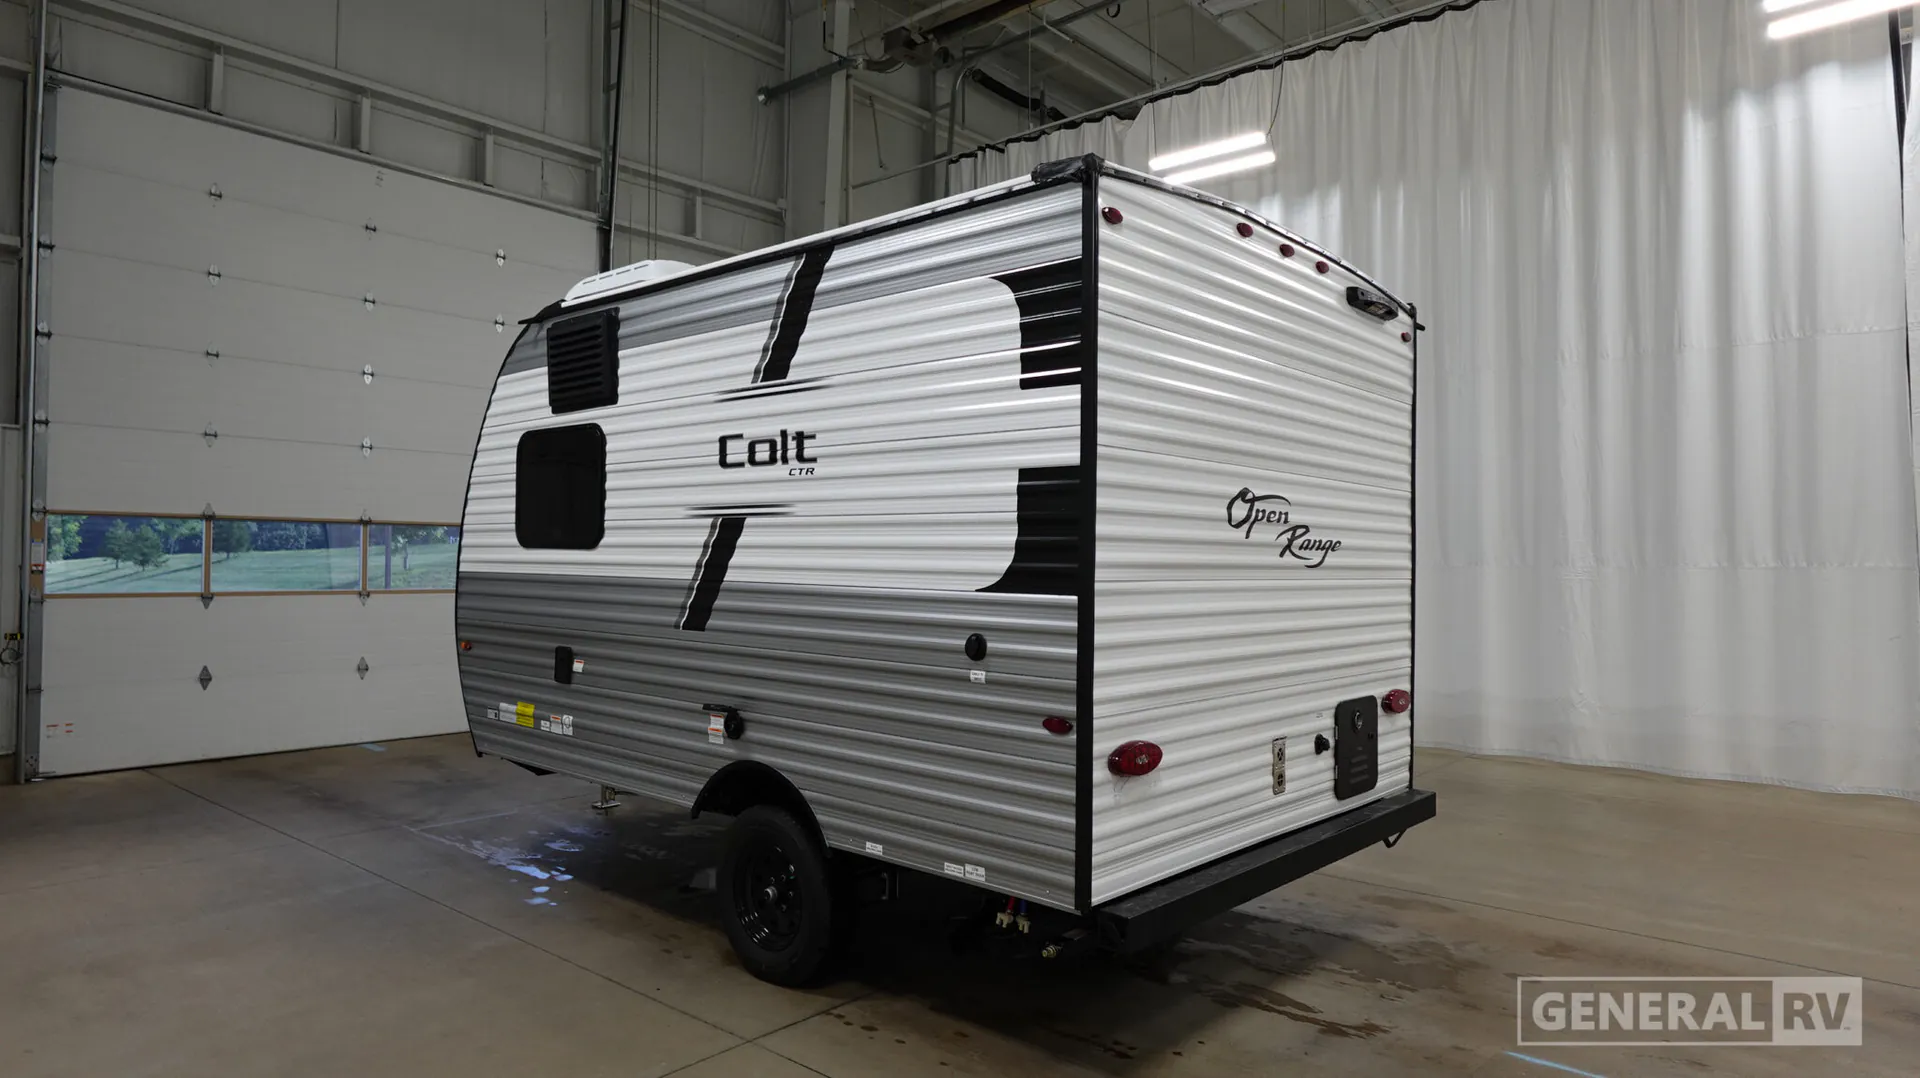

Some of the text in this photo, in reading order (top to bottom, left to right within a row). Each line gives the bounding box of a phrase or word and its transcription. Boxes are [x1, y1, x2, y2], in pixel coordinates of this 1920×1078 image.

[718, 428, 818, 469] Colt
[788, 467, 815, 476] CTR
[1226, 487, 1292, 539] Open
[1274, 524, 1342, 569] Range
